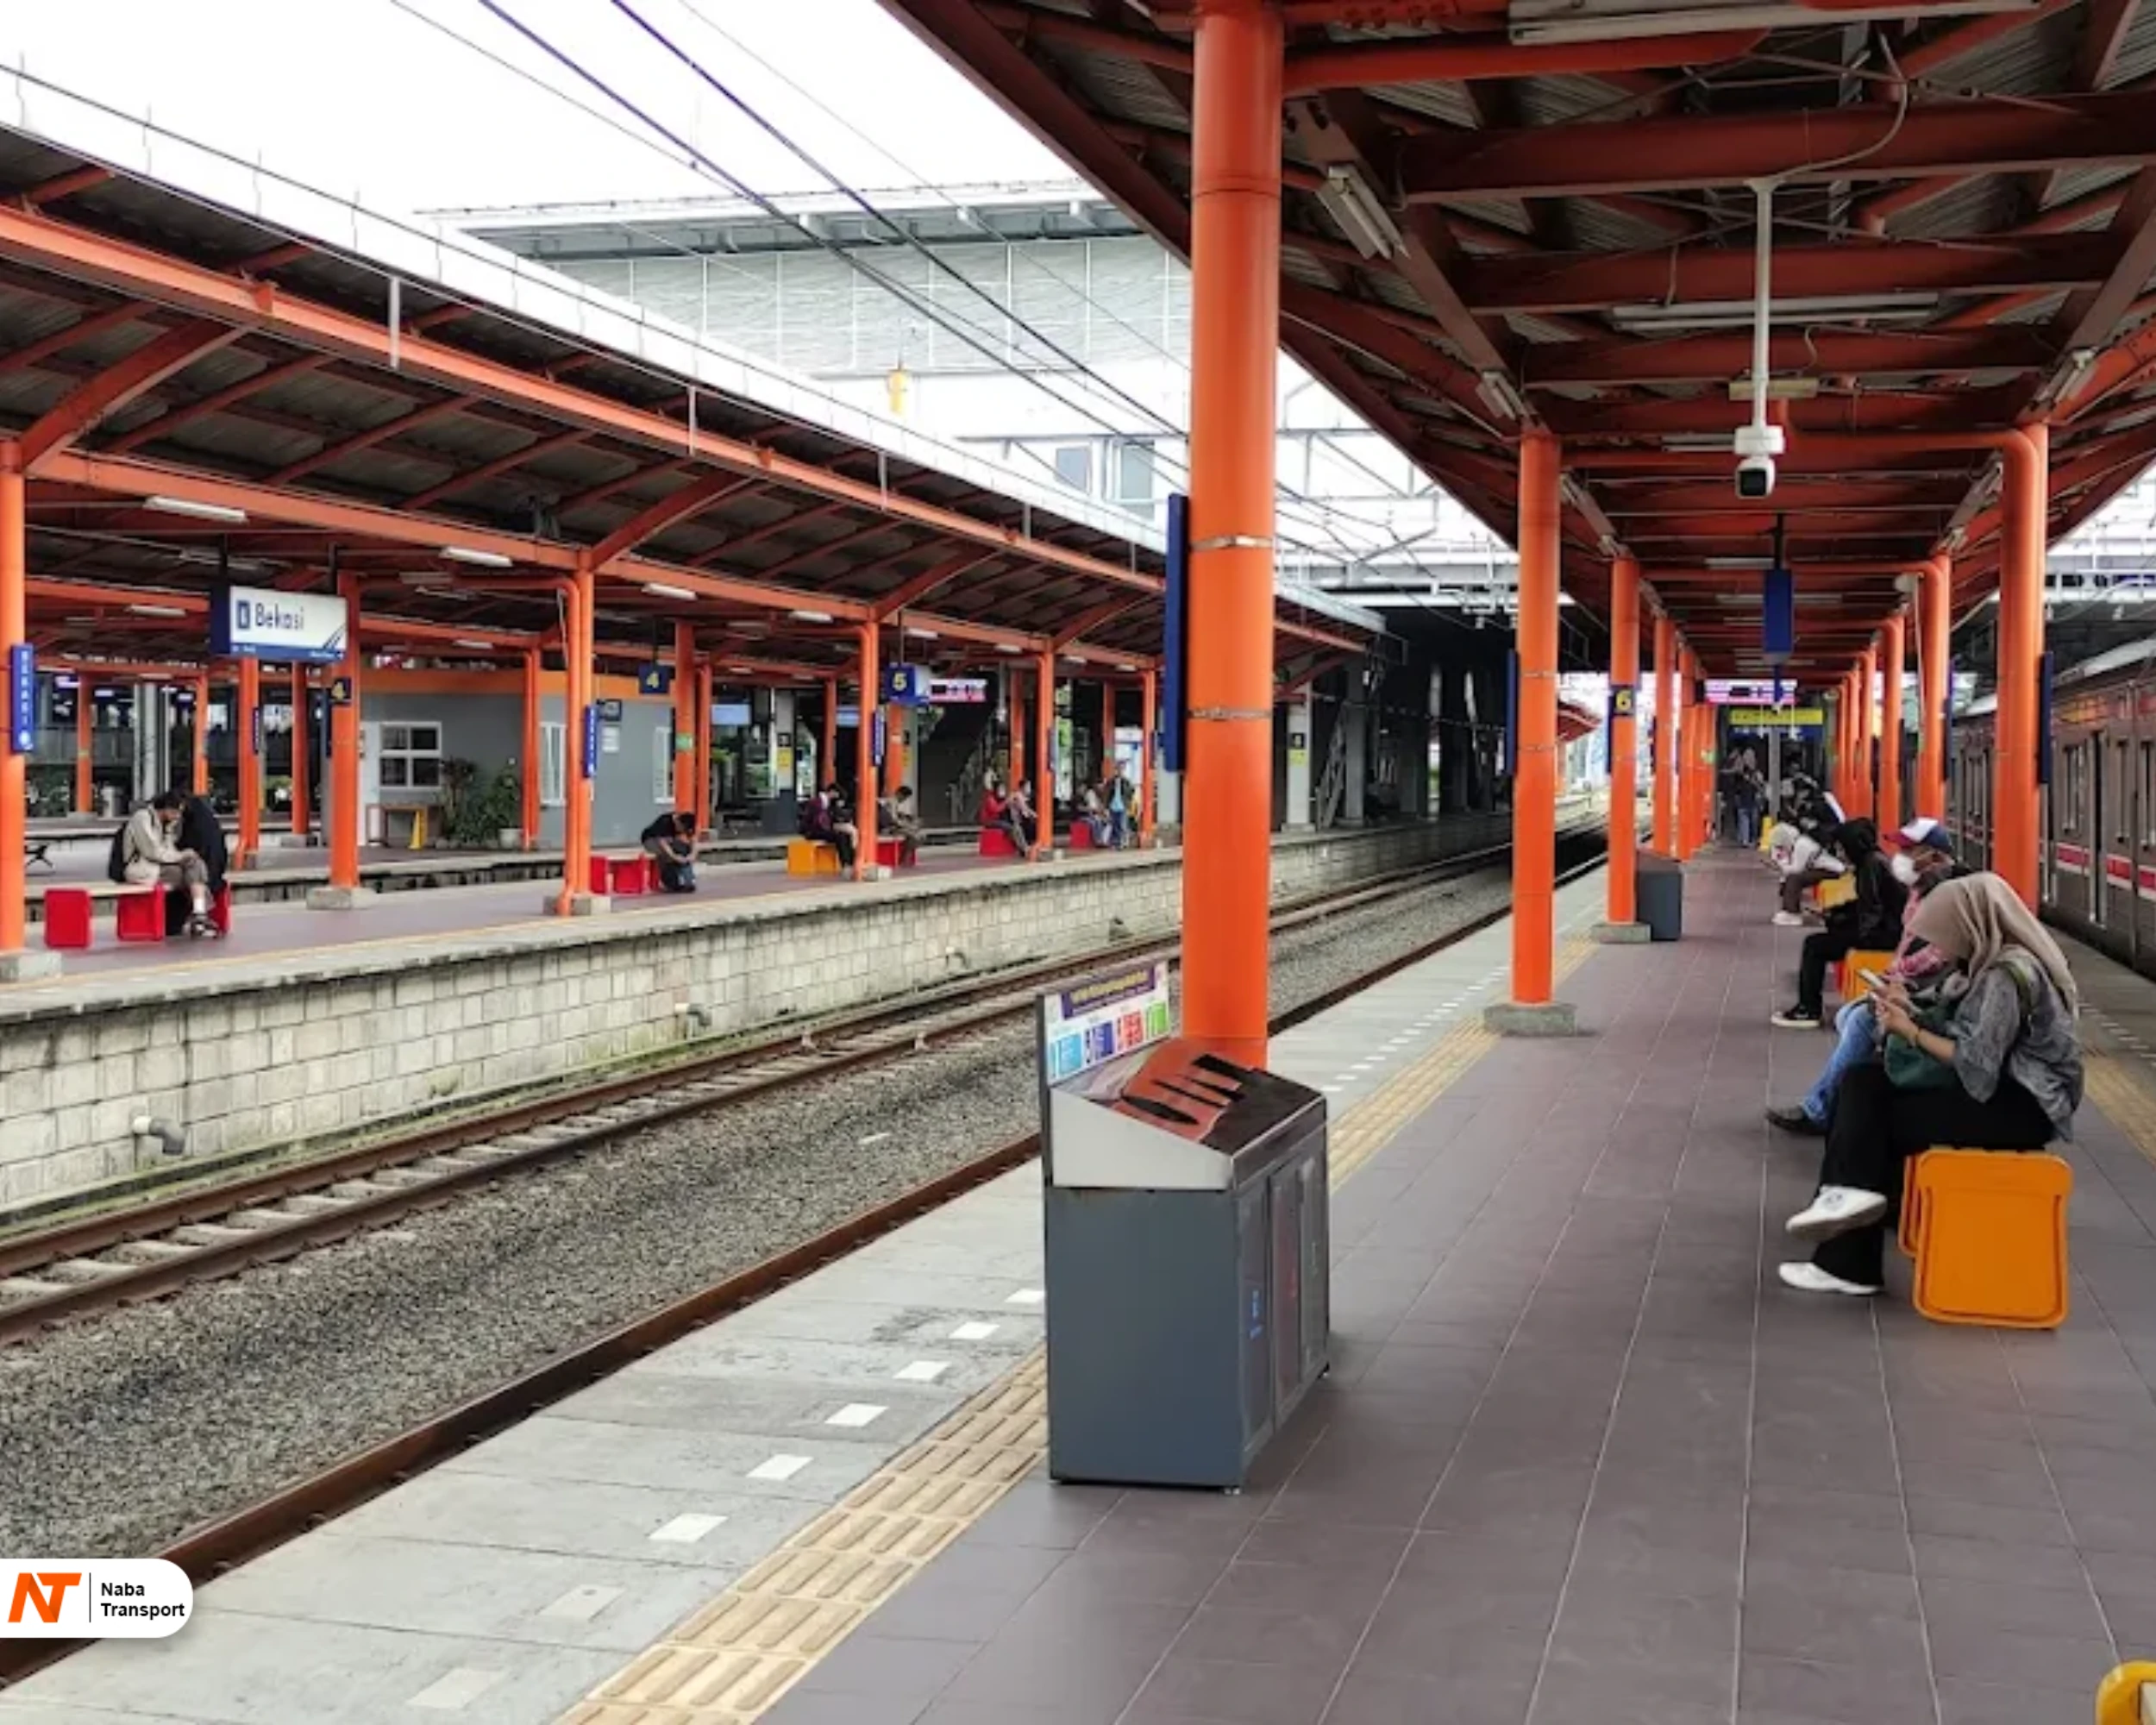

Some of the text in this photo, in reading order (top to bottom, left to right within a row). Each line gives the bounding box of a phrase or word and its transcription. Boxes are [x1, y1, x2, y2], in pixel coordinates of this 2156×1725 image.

[255, 602, 304, 630] Bekasi
[646, 672, 659, 688] 4
[893, 673, 907, 691] 5
[331, 681, 347, 700] 4
[1616, 690, 1631, 711] 6
